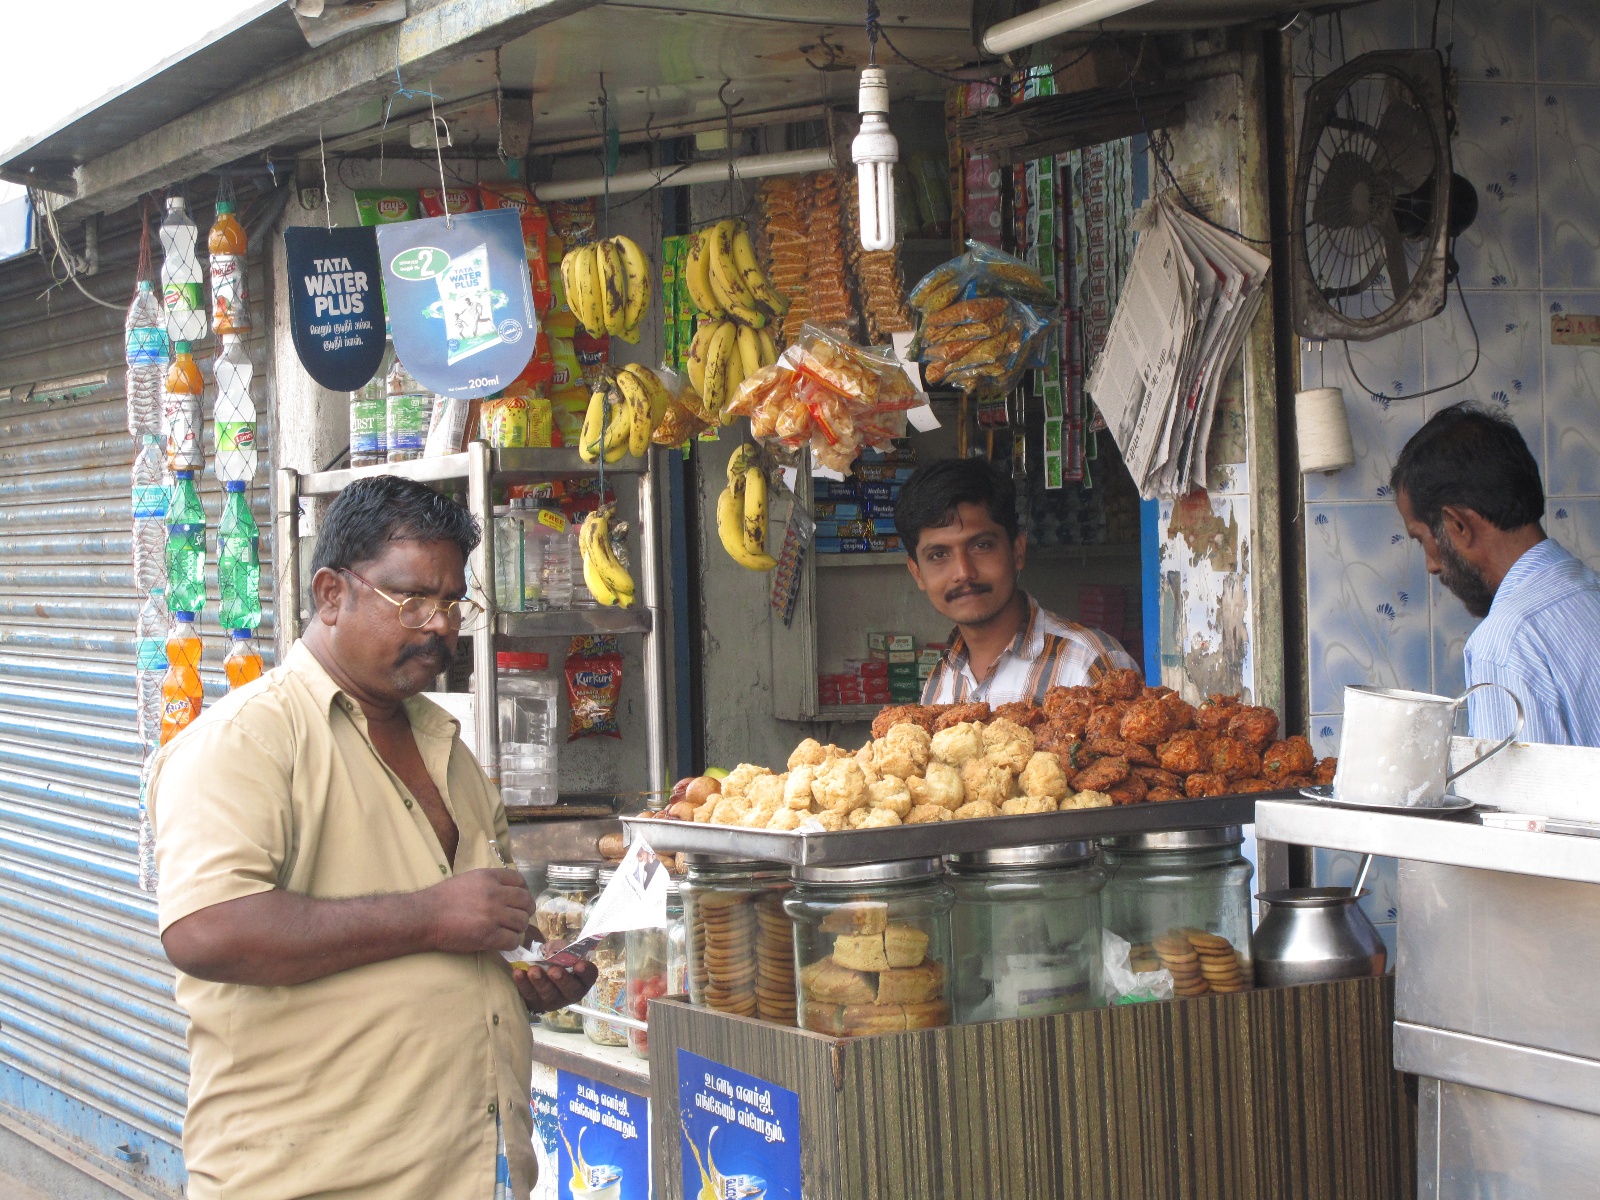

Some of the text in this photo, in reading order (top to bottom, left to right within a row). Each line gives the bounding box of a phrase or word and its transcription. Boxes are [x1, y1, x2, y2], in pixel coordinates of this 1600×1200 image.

[313, 257, 353, 274] TATA
[418, 249, 435, 277] 2
[454, 266, 474, 275] TATA
[304, 271, 369, 297] WATER
[449, 270, 482, 283] WATER
[454, 279, 480, 290] PLUS
[314, 292, 365, 318] PLUS
[468, 374, 500, 389] 200ml
[543, 512, 564, 526] FREE
[574, 671, 613, 688] Kurkure
[577, 1083, 600, 1106] உடனடி
[600, 1094, 630, 1118] எனர்ஜி,
[704, 1072, 774, 1116] உடனடி எனர்ஜி,
[569, 1098, 601, 1125] எங்கேயும்
[695, 1089, 786, 1143] எங்கேயும் எப்போதும்.
